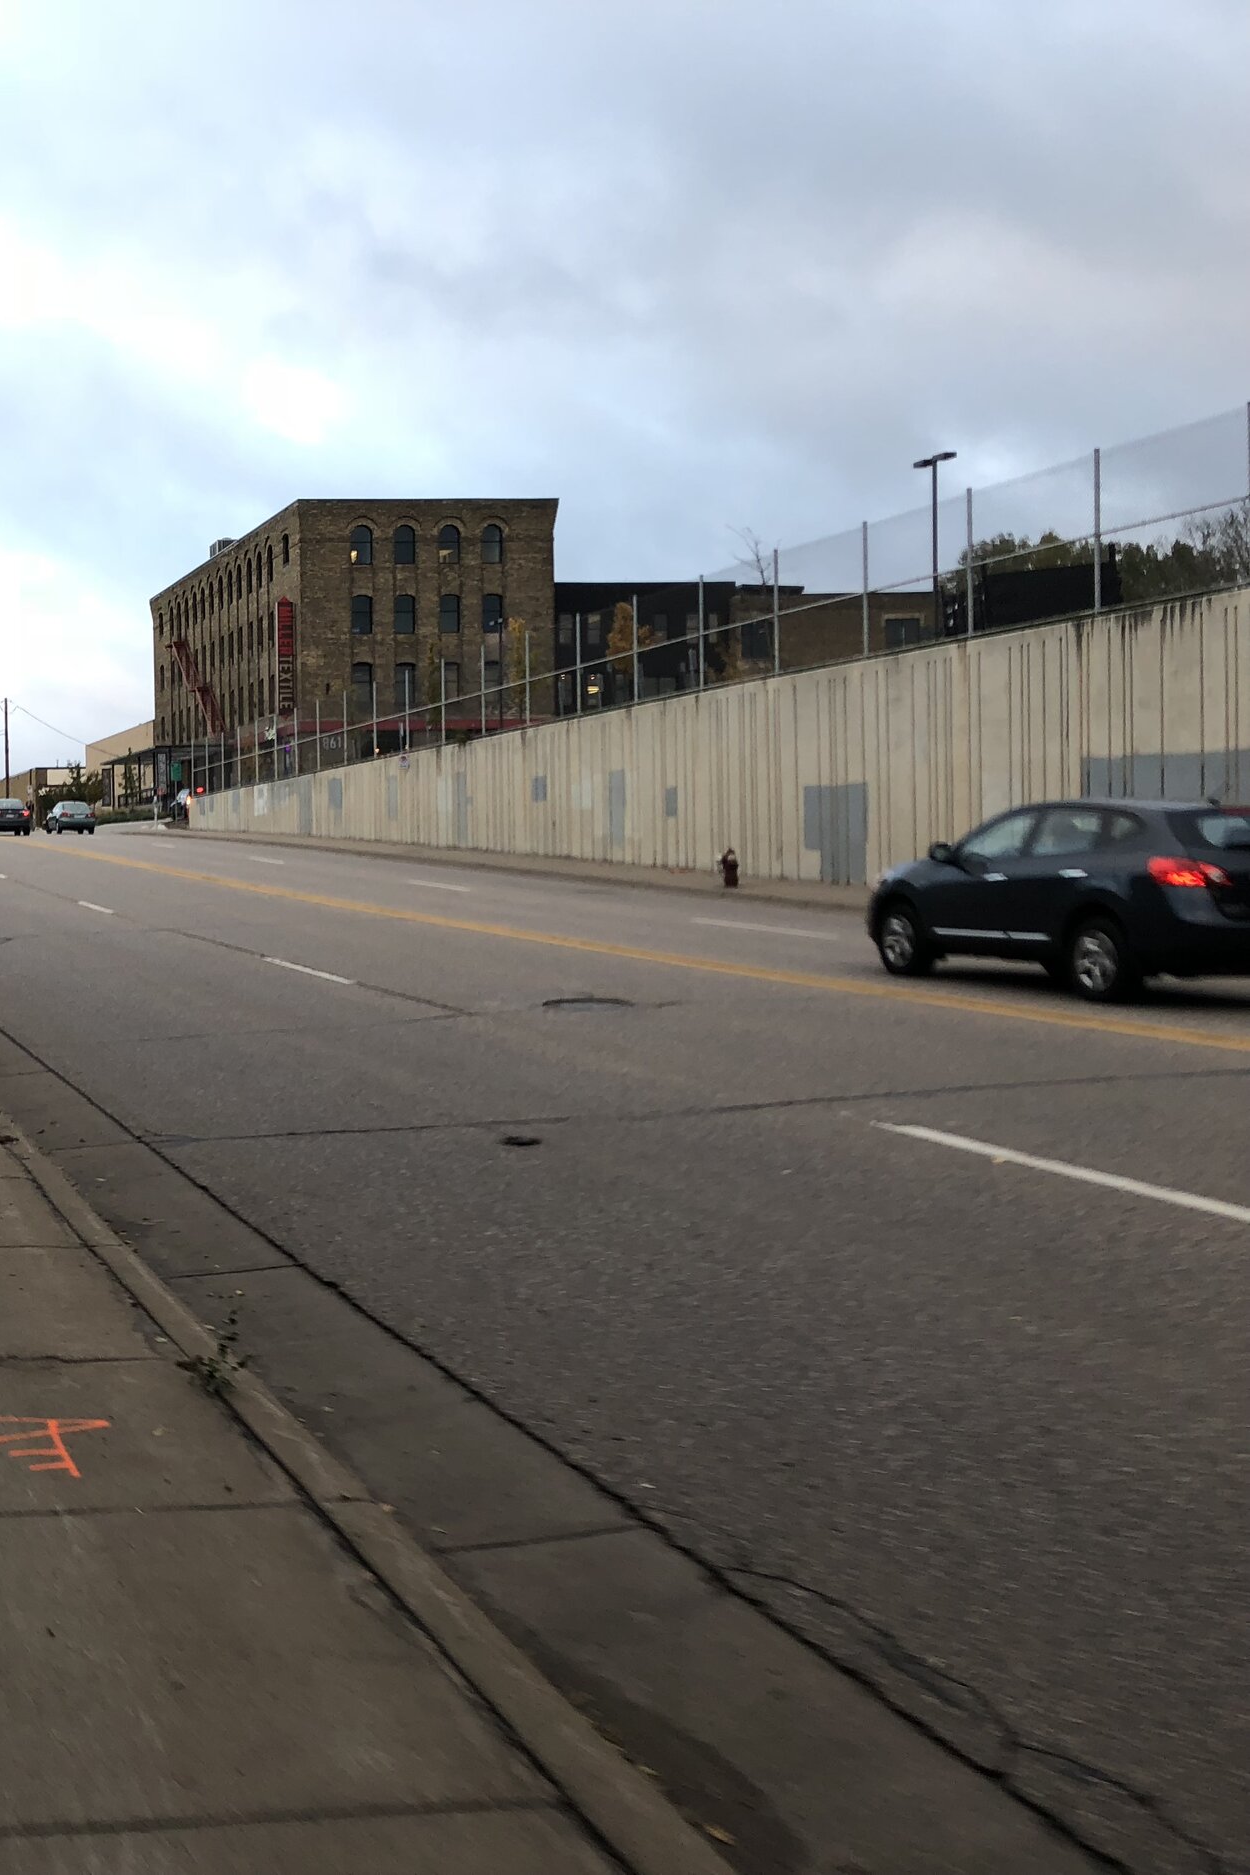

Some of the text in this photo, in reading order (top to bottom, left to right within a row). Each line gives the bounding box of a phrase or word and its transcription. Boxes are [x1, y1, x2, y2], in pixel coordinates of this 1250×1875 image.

[278, 606, 293, 710] MILLER TEXTILE
[322, 736, 341, 750] 861
